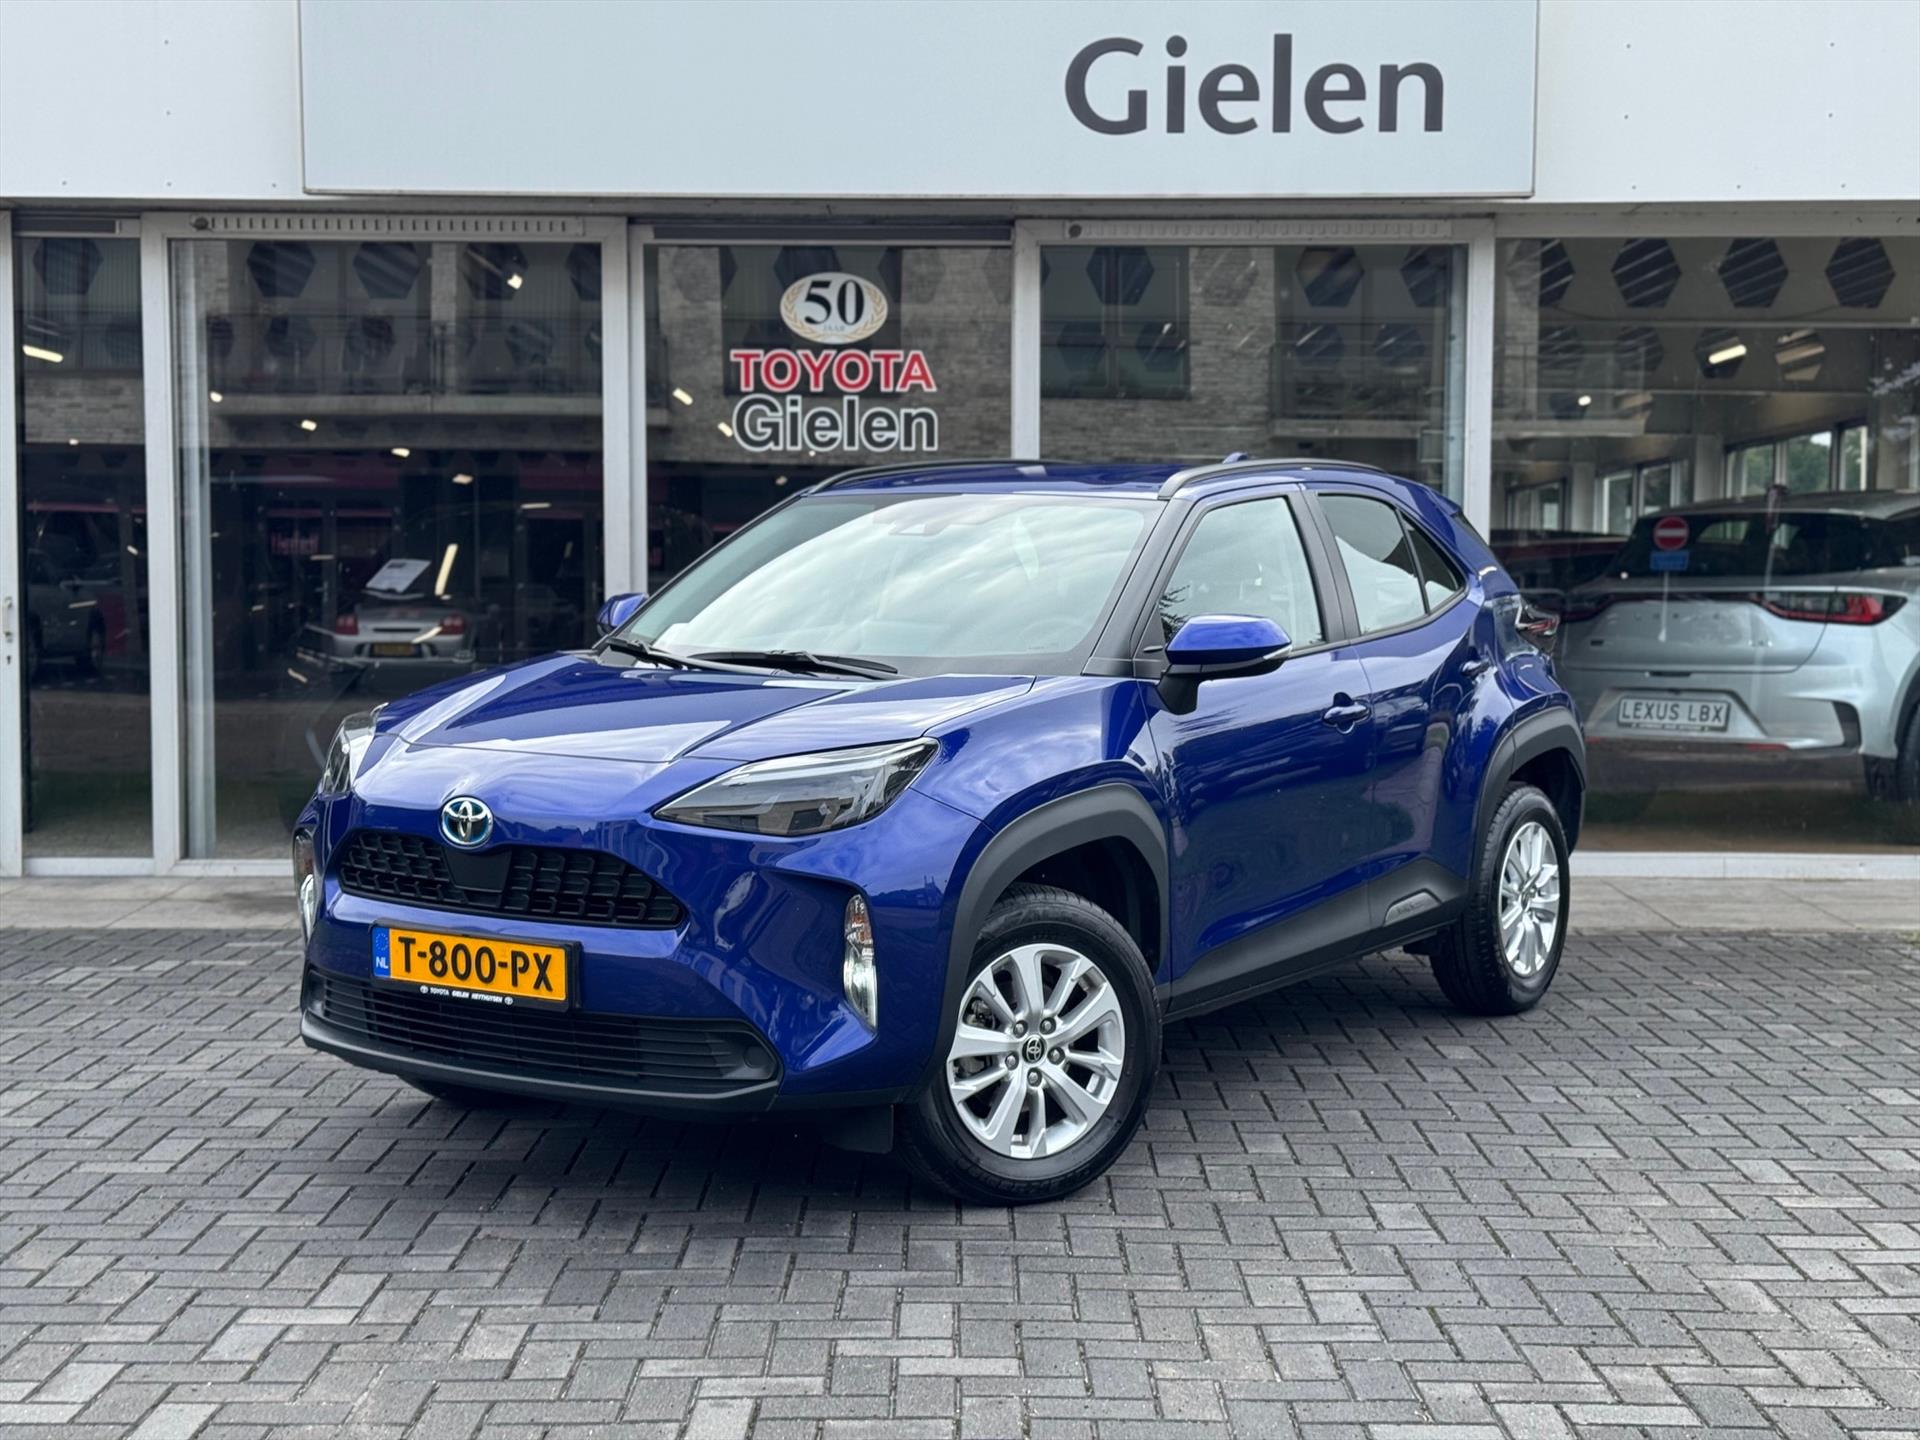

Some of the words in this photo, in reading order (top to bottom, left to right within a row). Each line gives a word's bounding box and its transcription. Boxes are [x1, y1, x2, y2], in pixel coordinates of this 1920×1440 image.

[1065, 33, 1443, 135] Gielen
[804, 279, 865, 325] 50
[730, 349, 937, 392] TOYOTA
[732, 393, 938, 452] Gielen
[1621, 701, 1680, 721] LEXUS
[1687, 704, 1724, 723] LBX
[375, 956, 389, 969] NL
[398, 936, 553, 992] T-800-PX
[429, 987, 450, 996] TOYOTA
[451, 990, 470, 999] GIELEN
